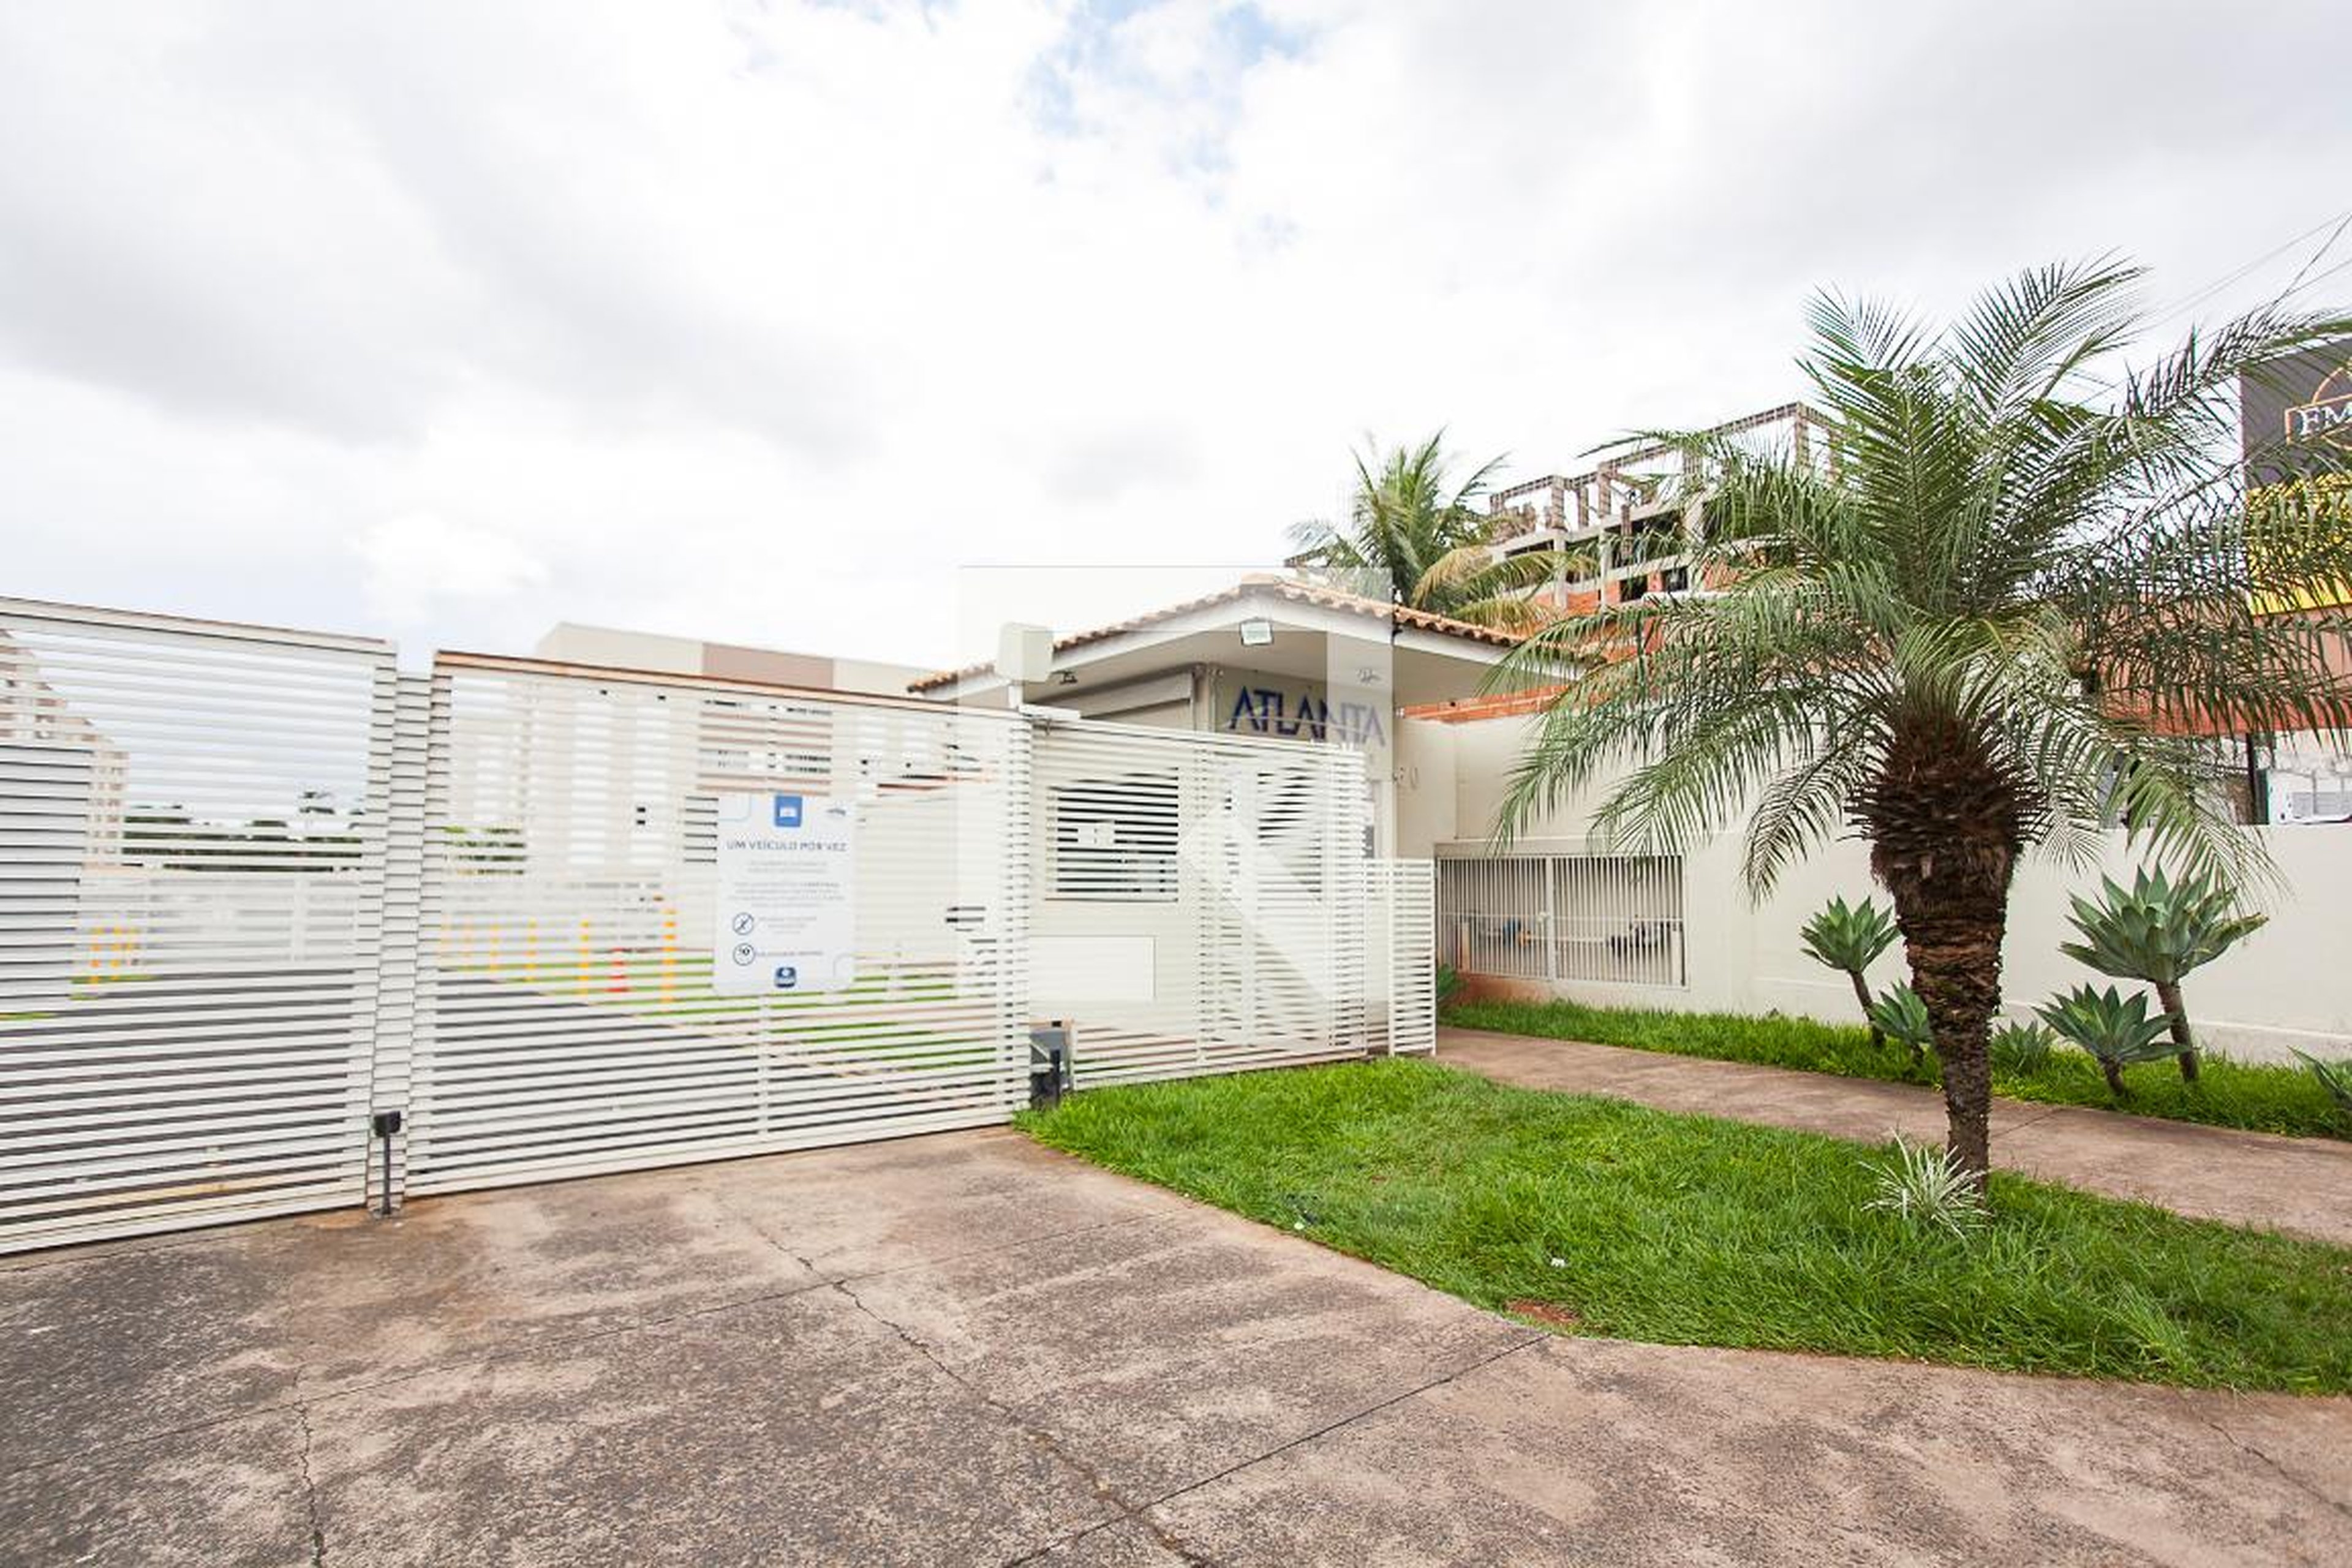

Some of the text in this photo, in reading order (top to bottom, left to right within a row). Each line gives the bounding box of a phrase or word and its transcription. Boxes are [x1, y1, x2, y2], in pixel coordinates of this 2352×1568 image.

[1229, 685, 1386, 747] ATLANTA
[726, 841, 745, 850] UM
[799, 842, 822, 851] POR
[824, 842, 847, 852] VEZ
